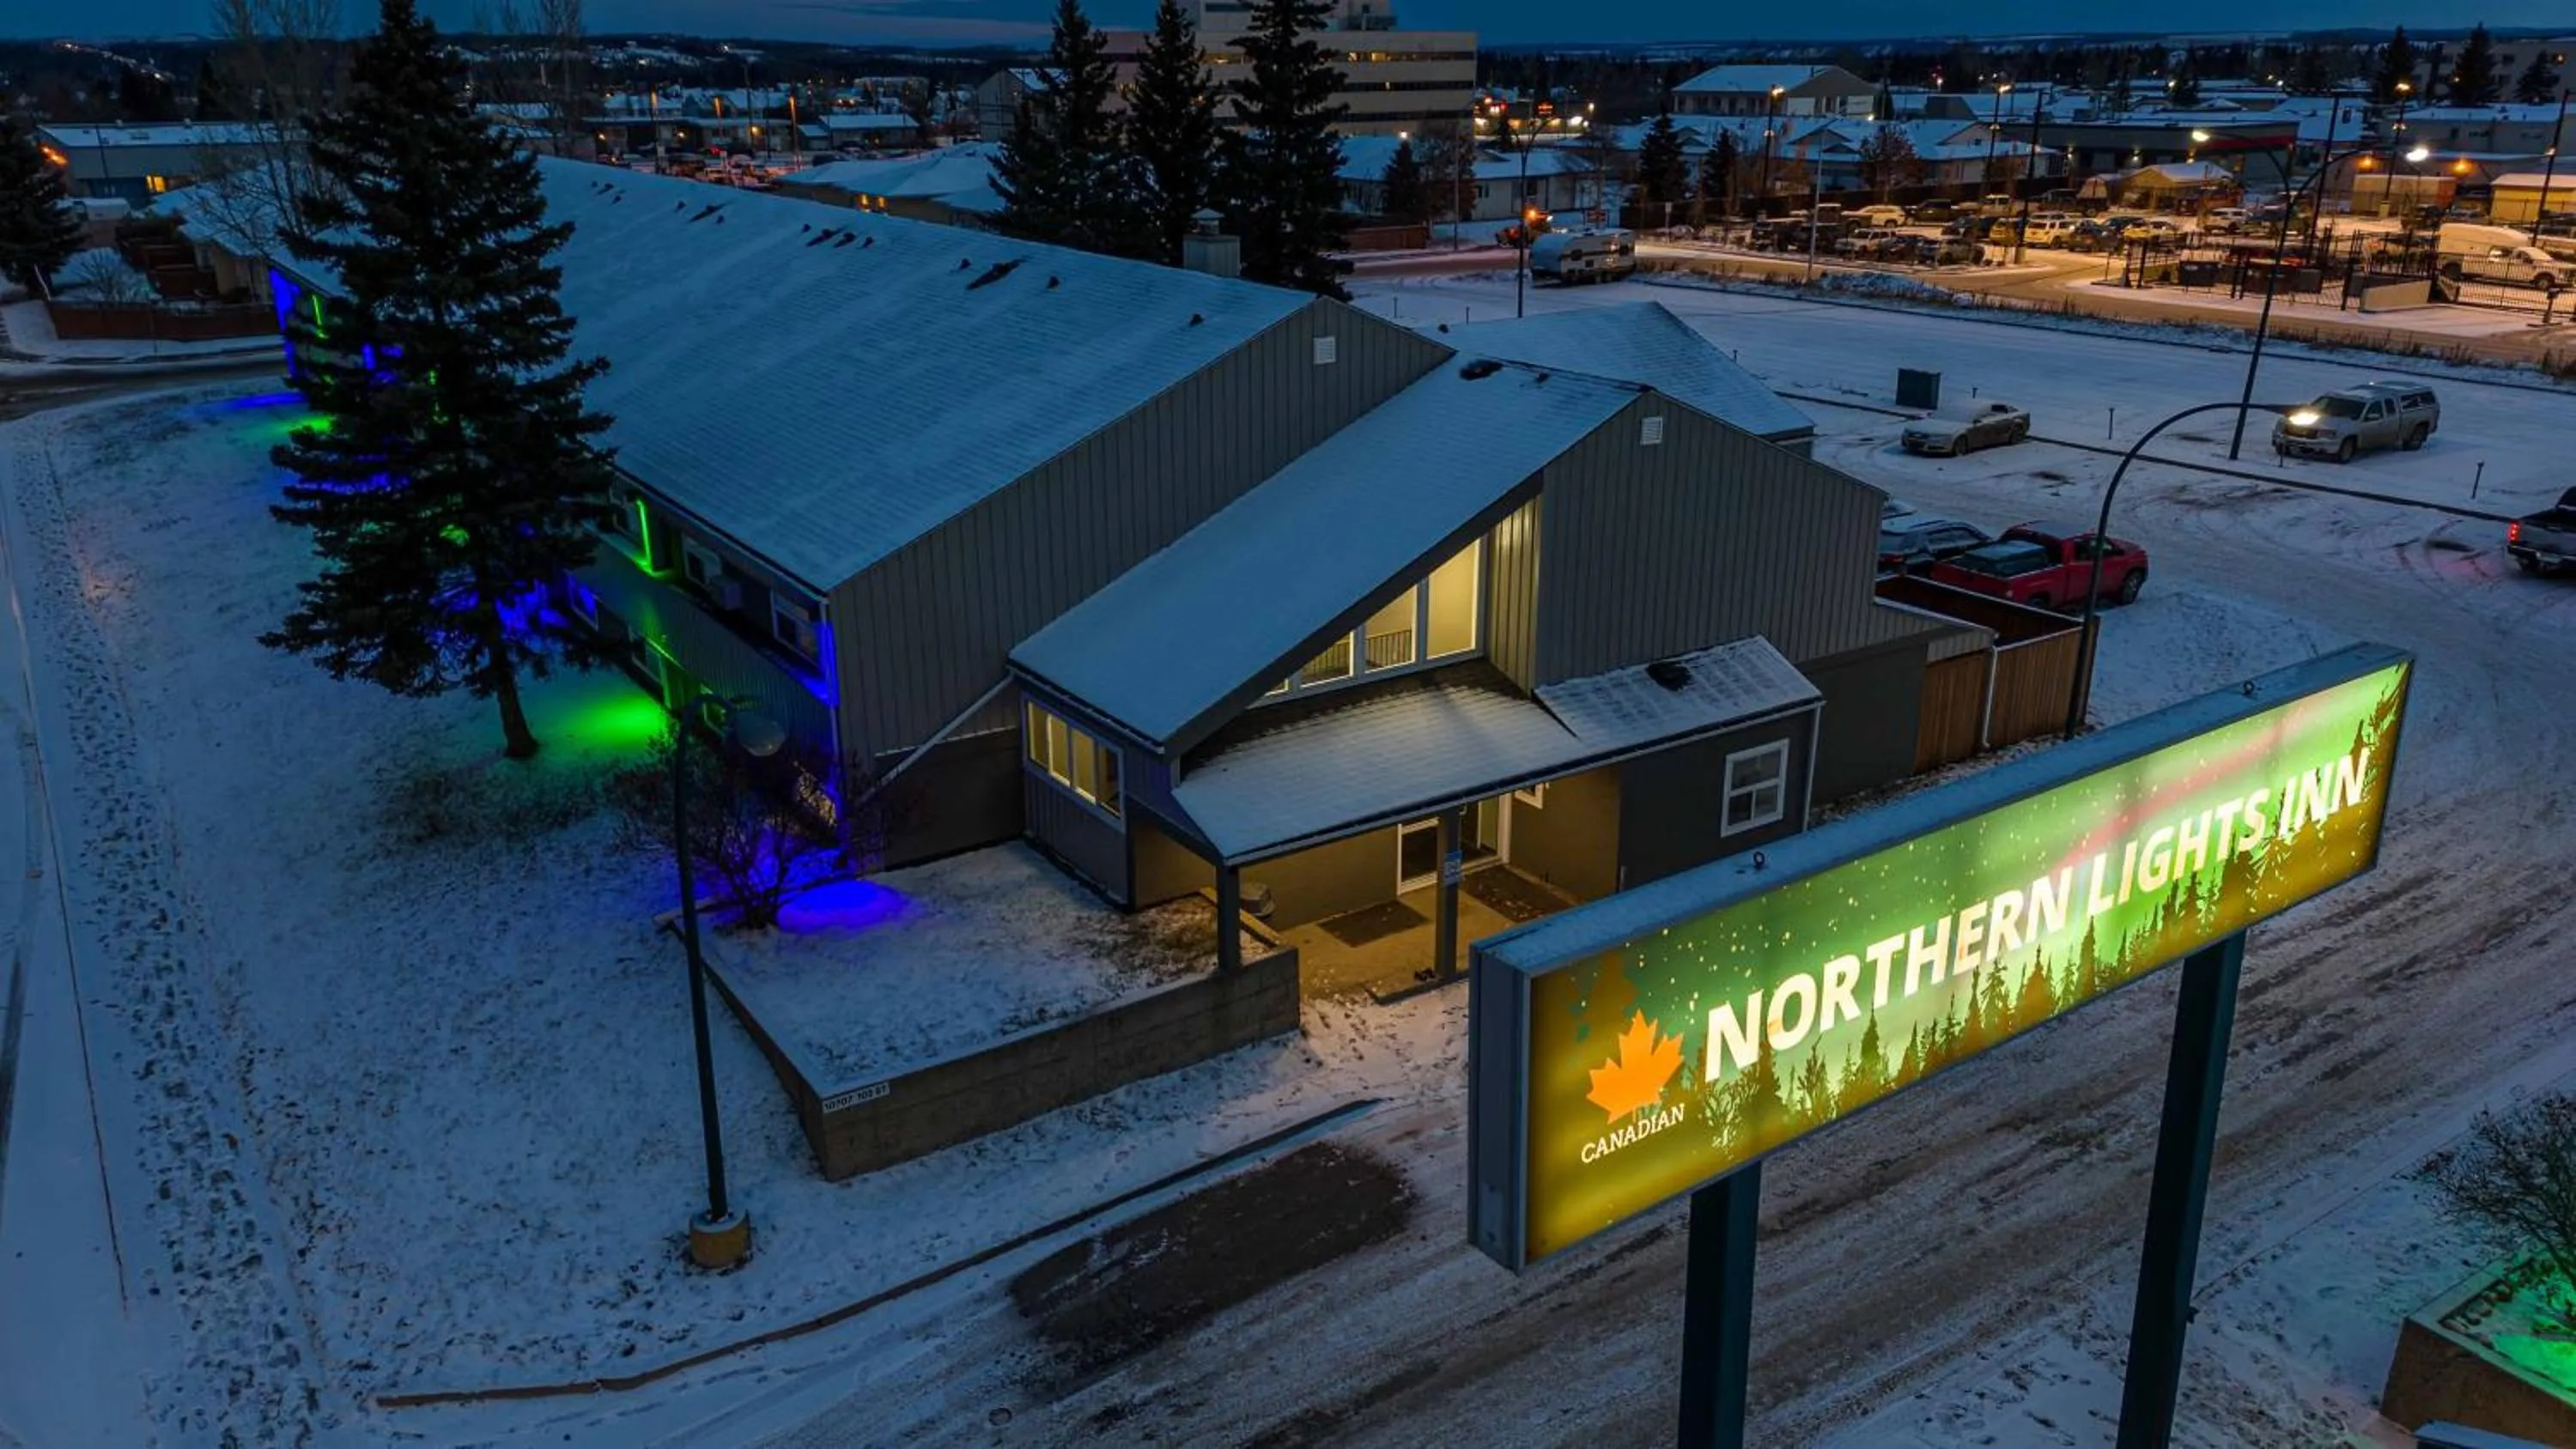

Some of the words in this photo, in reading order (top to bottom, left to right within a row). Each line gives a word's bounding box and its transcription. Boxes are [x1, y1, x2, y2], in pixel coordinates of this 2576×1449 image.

[1704, 865, 2075, 1083] NORTHERN
[2086, 786, 2271, 919] LIGHTS
[2276, 746, 2372, 840] INN
[1580, 1102, 1686, 1163] CANADIAN
